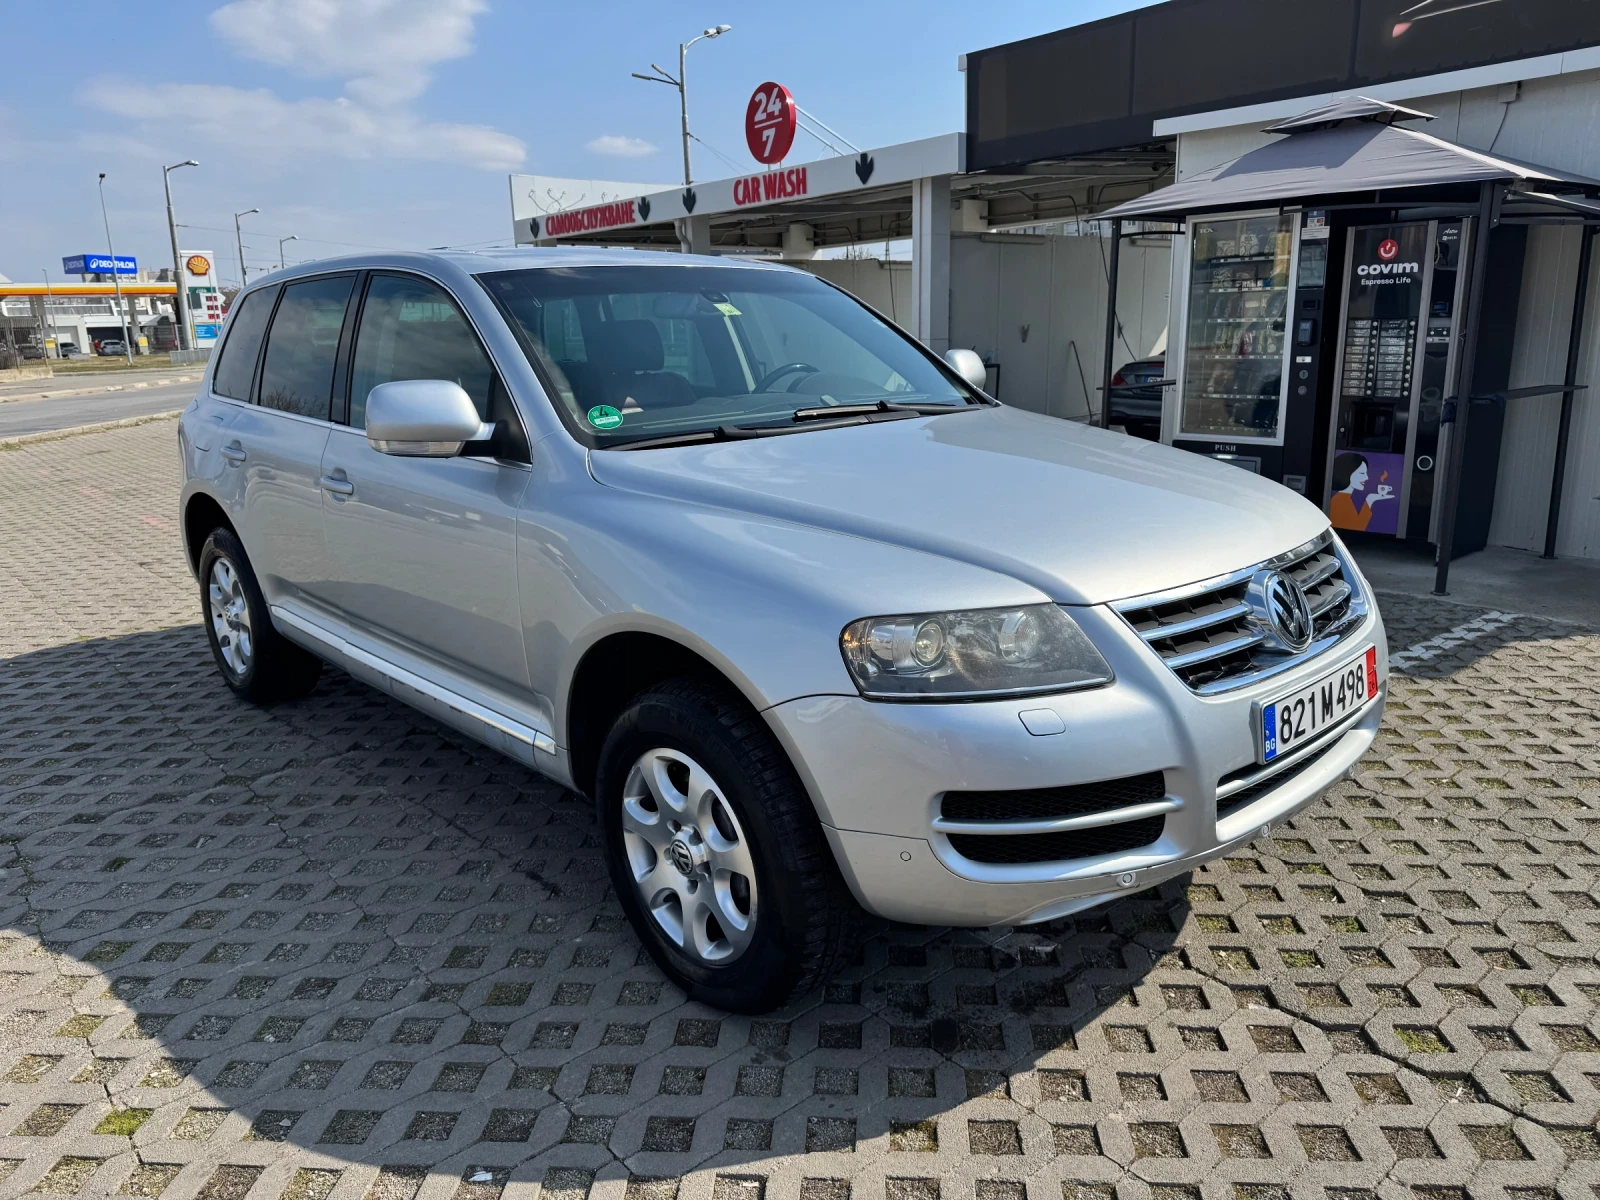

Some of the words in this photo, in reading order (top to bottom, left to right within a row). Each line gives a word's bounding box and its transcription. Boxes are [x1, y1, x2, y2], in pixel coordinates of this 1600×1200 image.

[754, 87, 782, 122] 24
[762, 127, 776, 158] 7
[733, 176, 761, 206] CAR
[762, 167, 807, 200] WASH
[545, 201, 636, 236] САМООБСЛУЖВАНЕ
[99, 260, 135, 269] DECTHLON
[1215, 444, 1236, 452] PUSH
[1265, 738, 1276, 753] BG
